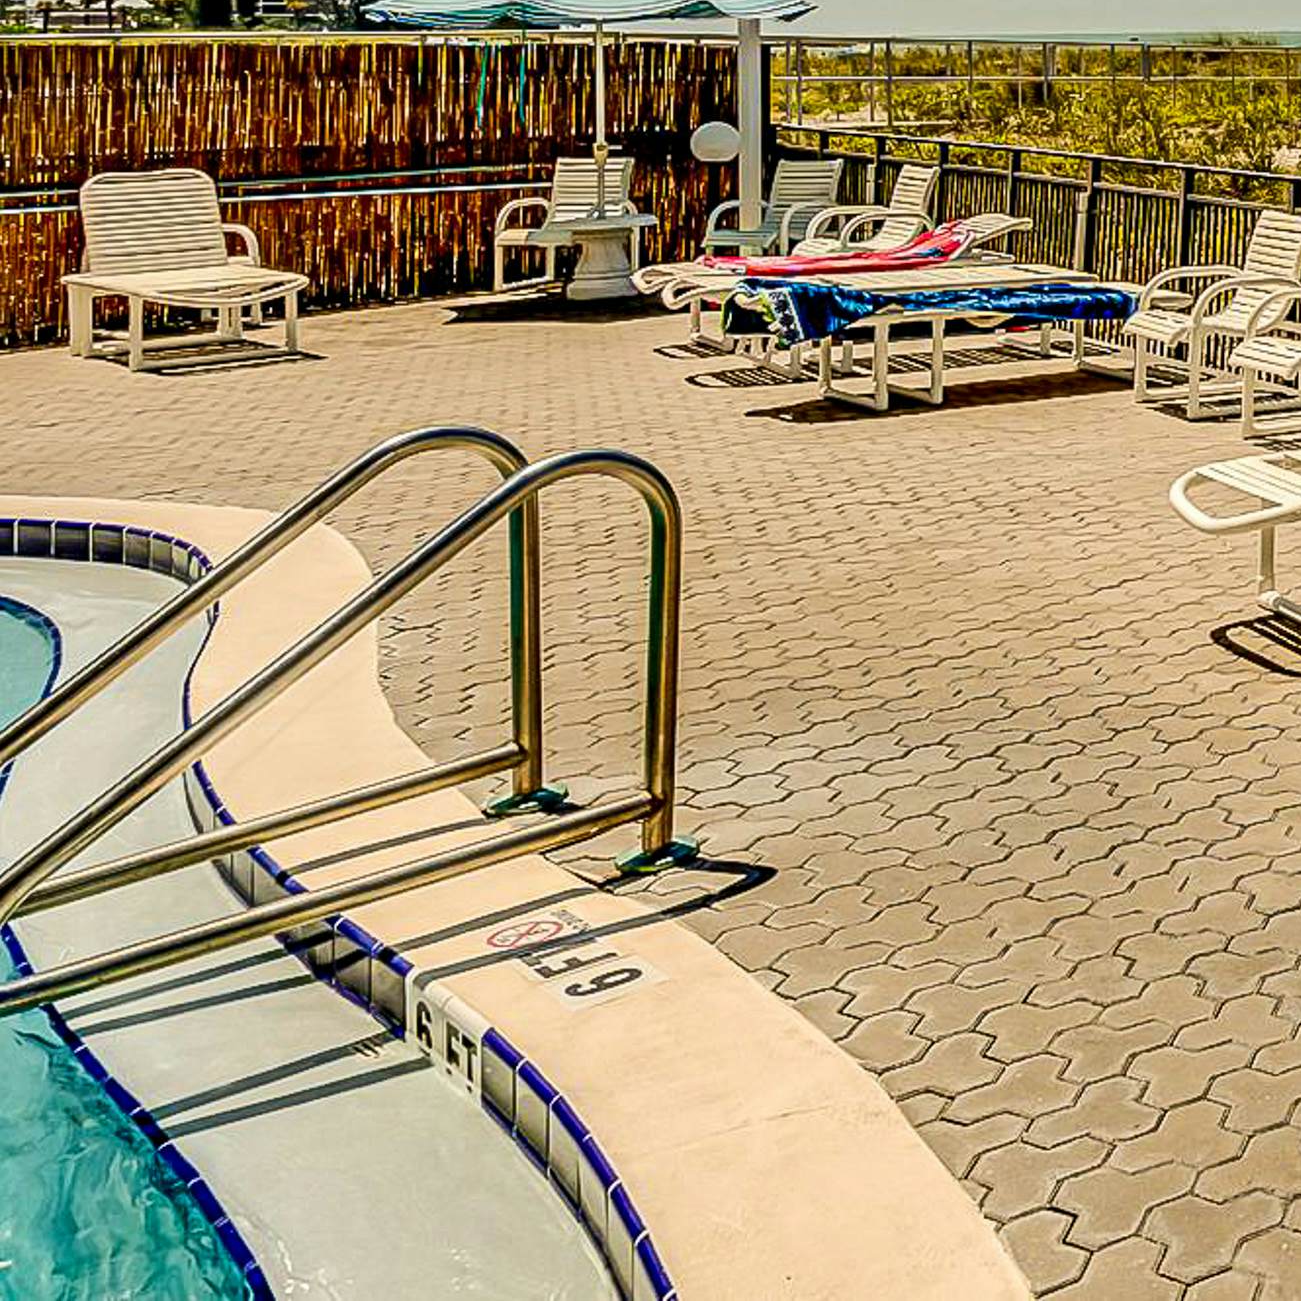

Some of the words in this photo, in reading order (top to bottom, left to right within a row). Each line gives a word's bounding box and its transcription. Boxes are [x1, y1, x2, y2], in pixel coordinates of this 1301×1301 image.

[565, 968, 643, 996] 6
[416, 1000, 432, 1056] 6
[446, 1021, 478, 1094] FT
